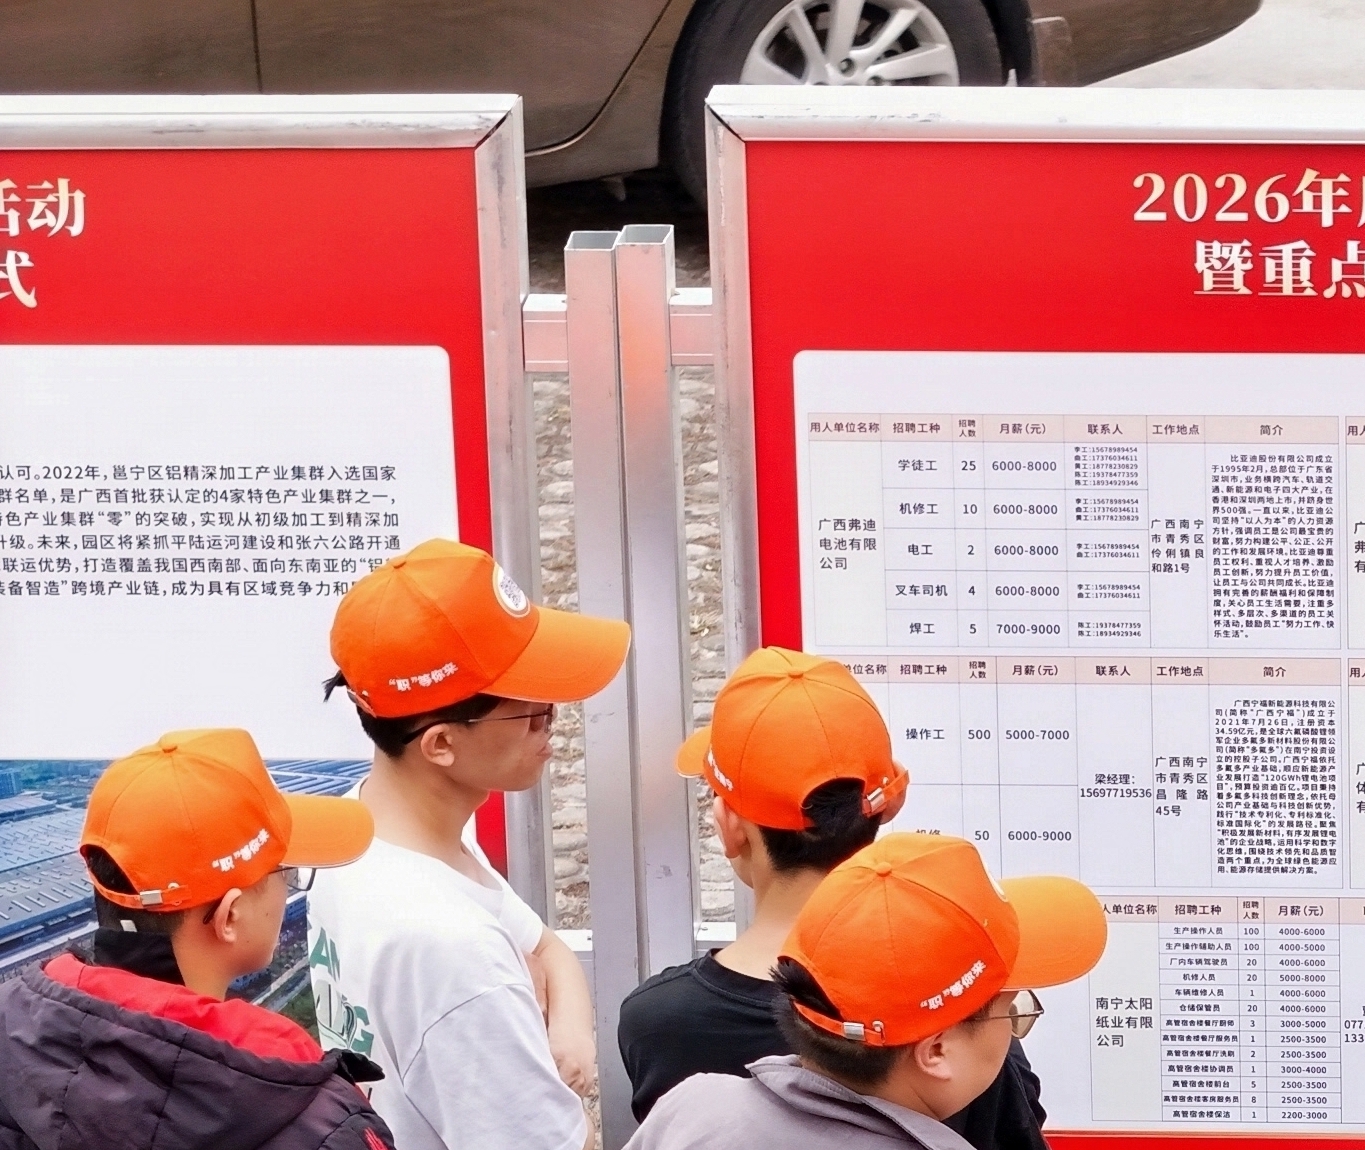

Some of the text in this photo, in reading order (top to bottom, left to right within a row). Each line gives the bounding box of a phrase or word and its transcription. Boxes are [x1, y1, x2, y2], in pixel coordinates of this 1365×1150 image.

[810, 422, 879, 433] 用人单位名称
[893, 423, 940, 433] 招聘工种
[1088, 424, 1123, 434] 联系人
[1153, 424, 1199, 435] 工作地点
[1260, 425, 1283, 435] 简介
[898, 460, 937, 471] 学徒工
[962, 461, 976, 471] 25
[992, 461, 1056, 471] 6000-8000
[0, 511, 398, 527] 色产业集群“零”的突破，实现从初级加工到精深加
[819, 518, 876, 531] 广西弗迪
[1151, 519, 1204, 529] 广西南宁
[820, 538, 876, 550] 电池有限
[1151, 534, 1204, 544] 市青秀区
[3, 558, 392, 573] 联运优势，打造覆盖我国西南部、面向东南亚的“铝
[820, 557, 847, 570] 公司
[1152, 563, 1189, 573] 和路1号
[0, 578, 359, 597] 备智造”跨境产业链，成为具有区域竞争力和
[896, 584, 948, 596] 叉车司机
[910, 623, 935, 634] 焊工
[997, 624, 1060, 634] 7000-9000
[906, 728, 945, 740] 操作工
[968, 730, 990, 739] 500
[1006, 730, 1069, 740] 5000-7000
[1081, 788, 1152, 798] 15697719536
[1156, 805, 1181, 816] 45号
[1008, 831, 1071, 841] 6000-9000
[1183, 973, 1215, 981] 机修人员
[1096, 997, 1152, 1010] 南宁太阳
[1096, 1016, 1153, 1028] 纸业有限
[1097, 1035, 1123, 1047] 公司
